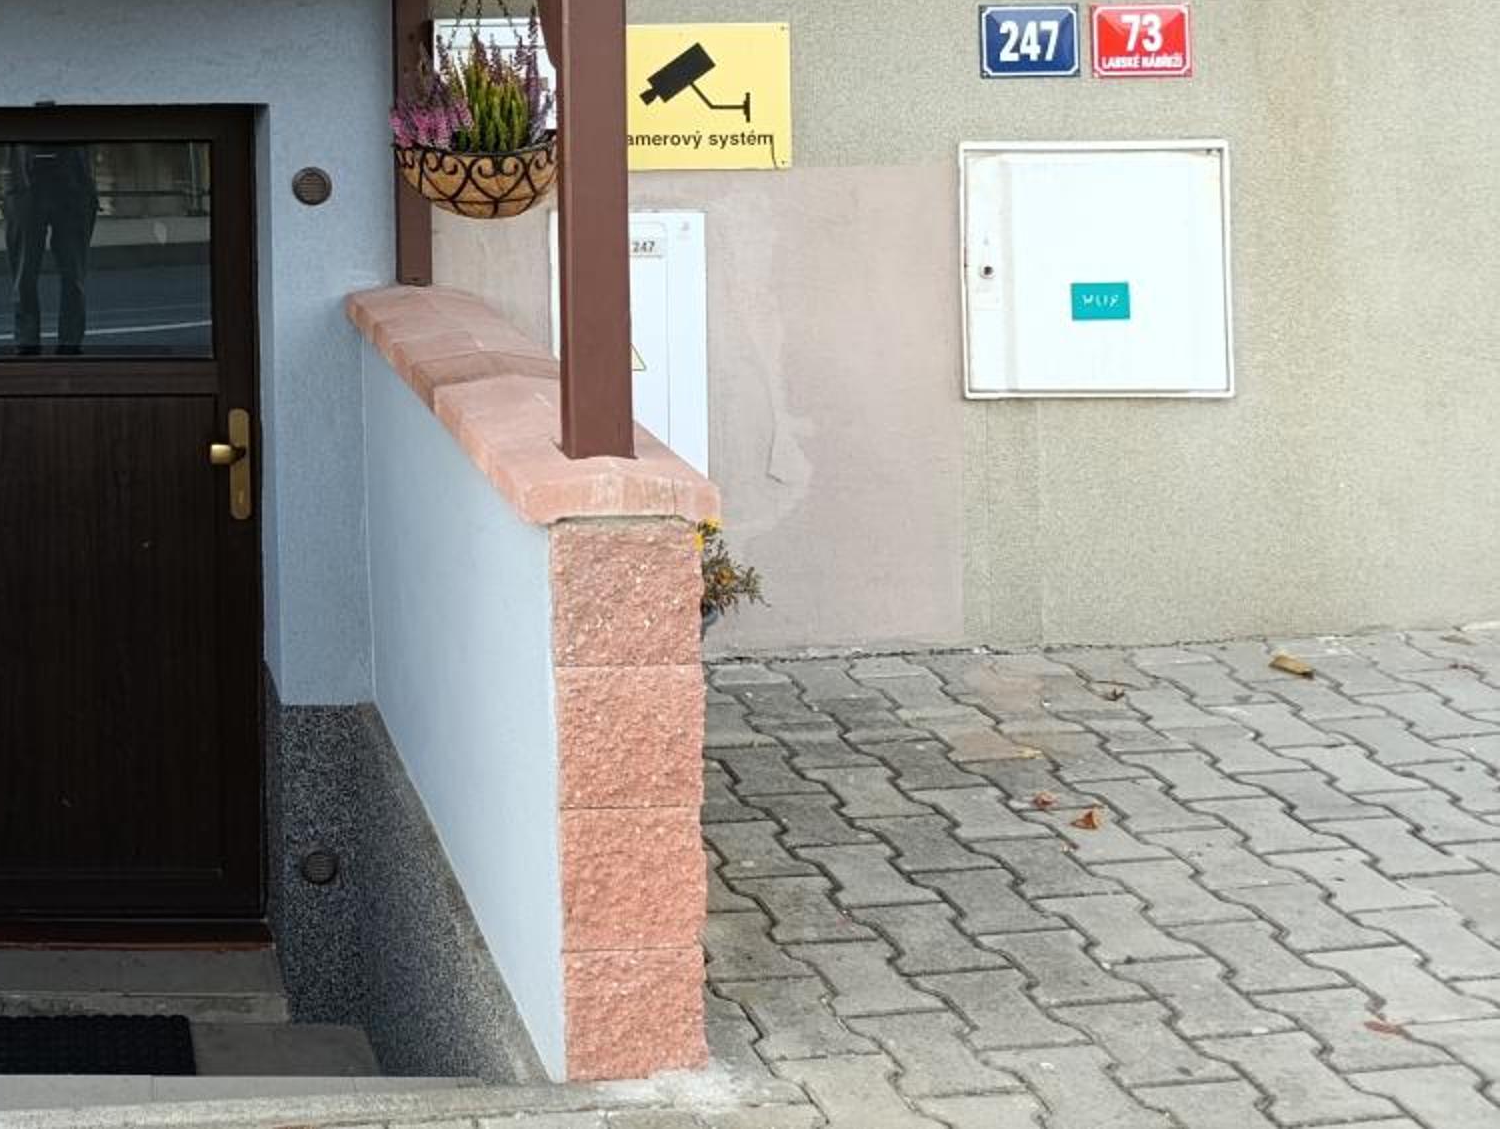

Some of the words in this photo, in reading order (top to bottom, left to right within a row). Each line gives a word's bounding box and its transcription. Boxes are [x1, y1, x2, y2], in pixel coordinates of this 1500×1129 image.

[999, 20, 1059, 62] 247
[1121, 13, 1164, 52] 73
[627, 130, 703, 150] amerový
[708, 130, 773, 150] systém
